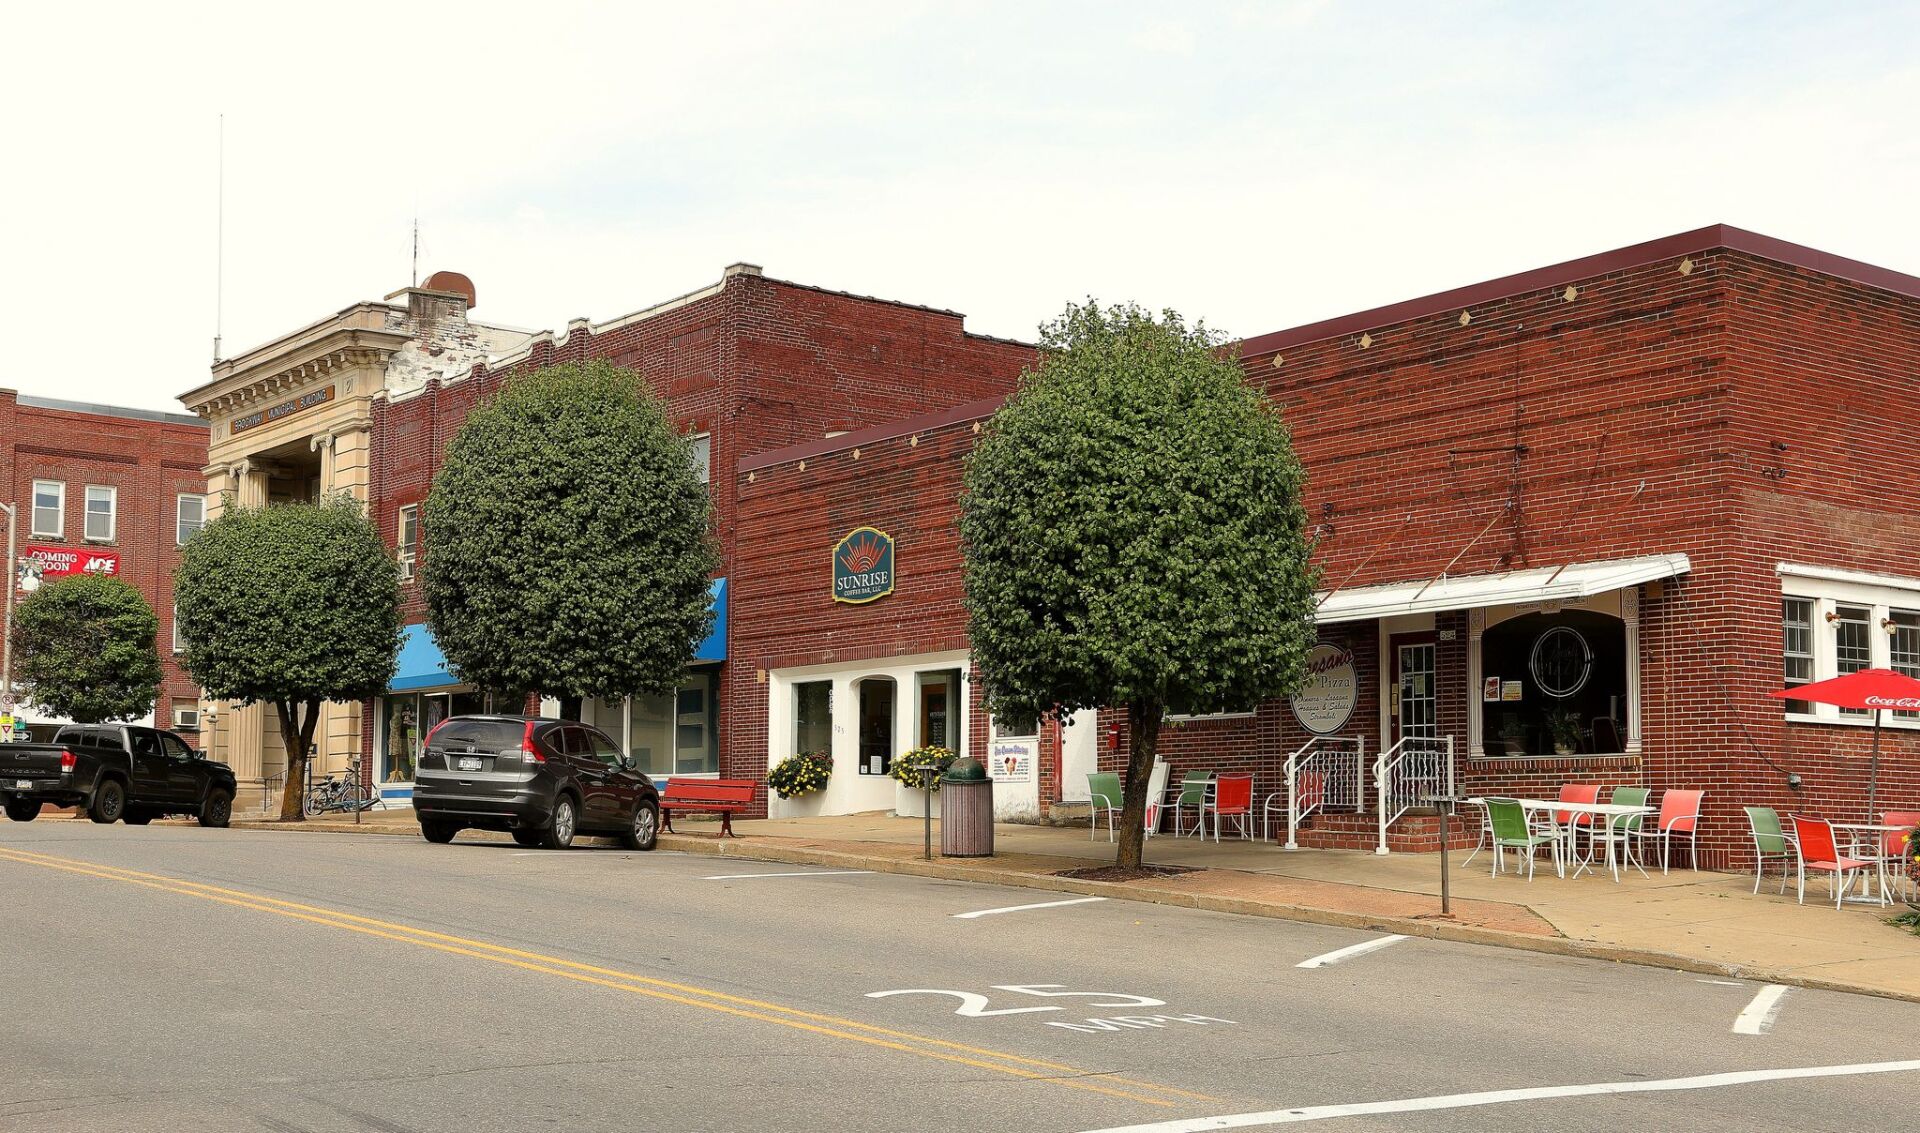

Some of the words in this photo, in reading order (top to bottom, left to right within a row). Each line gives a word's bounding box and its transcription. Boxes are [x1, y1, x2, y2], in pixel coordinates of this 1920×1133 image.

[235, 413, 263, 431] BROCKWAY
[267, 400, 297, 420] MUNICIPAL
[300, 389, 328, 408] BUILDING
[32, 551, 77, 563] COMING
[82, 556, 116, 574] ACE
[837, 571, 889, 590] SUNRISE
[844, 588, 861, 596] COFFEE
[1305, 648, 1354, 674] esano
[1320, 675, 1350, 688] Pizza
[1865, 695, 1920, 707] Coca-Col
[864, 984, 1167, 1018] 25
[1044, 1013, 1239, 1033] MPH
